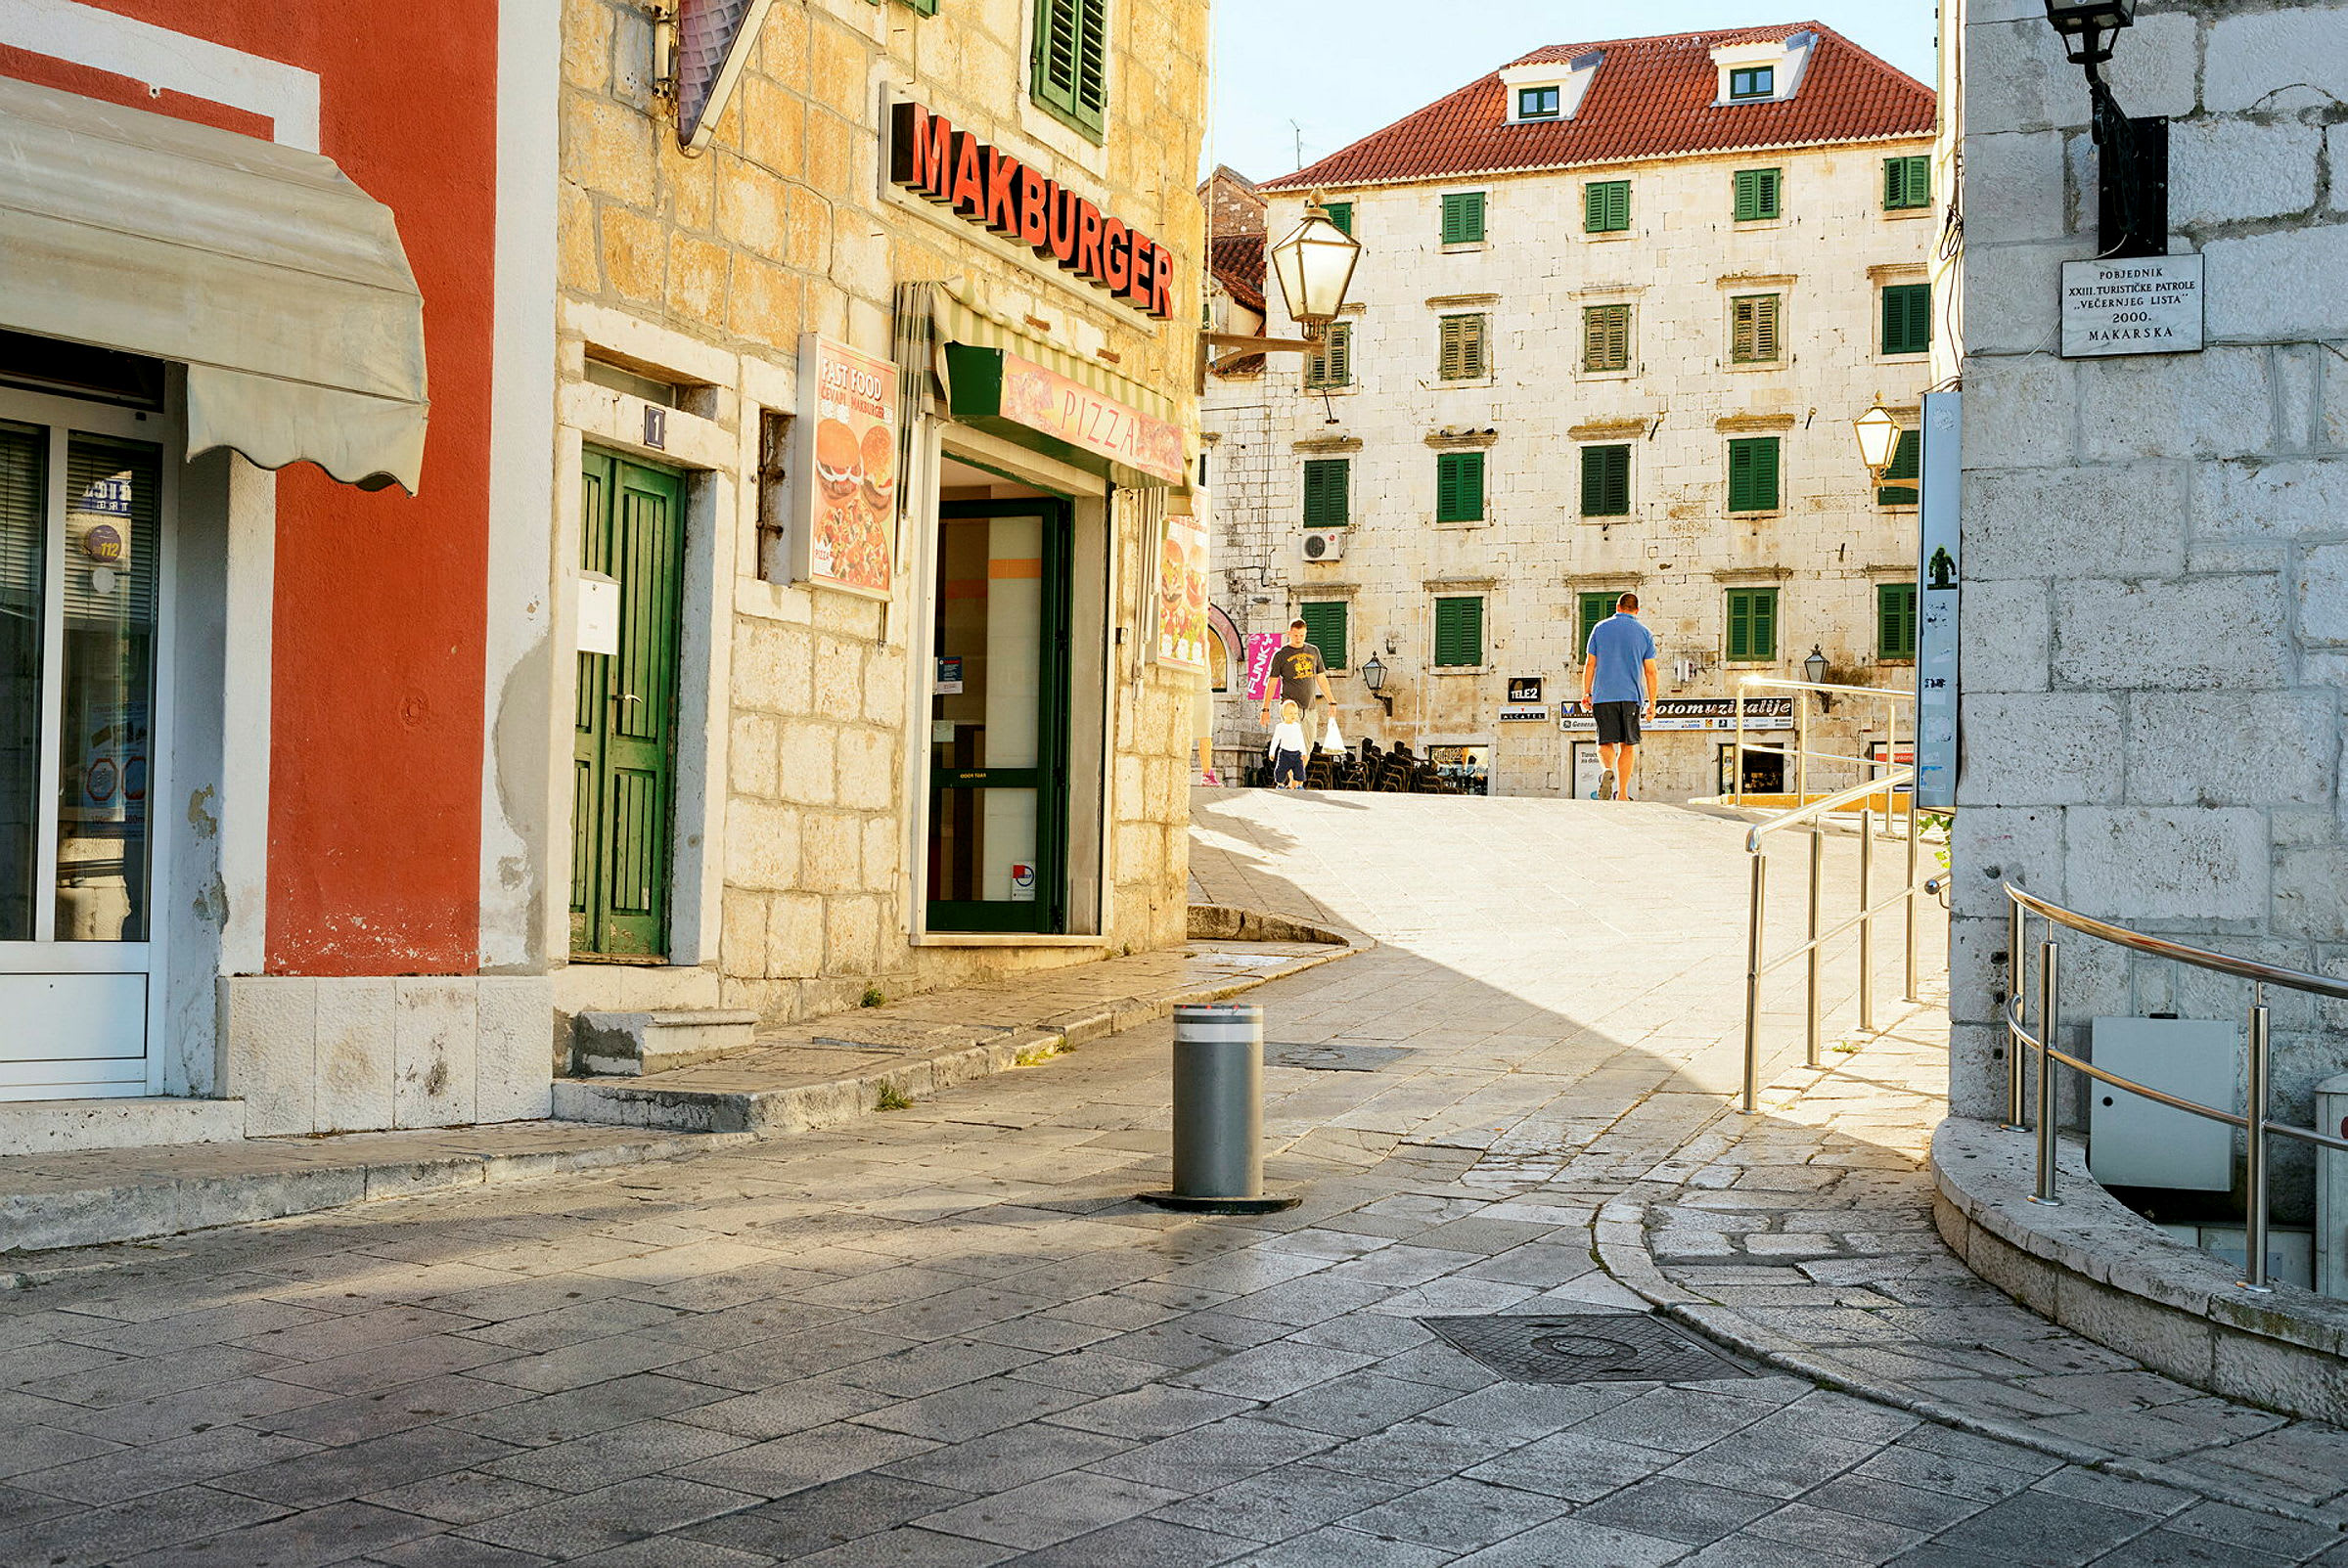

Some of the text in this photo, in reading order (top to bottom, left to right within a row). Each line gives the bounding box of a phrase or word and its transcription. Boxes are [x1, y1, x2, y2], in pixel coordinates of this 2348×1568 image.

[912, 102, 1173, 321] MAKBURGER
[2100, 267, 2163, 280] POBJEDNIK
[2097, 282, 2152, 295] TURISTIČKE
[2155, 281, 2195, 291] PATROLE
[2112, 311, 2152, 324] 2000.
[2089, 327, 2173, 341] MAKARSKA
[822, 356, 882, 401] FAST FOOD
[655, 415, 660, 441] 1
[1061, 390, 1134, 457] PIZZA
[102, 543, 118, 557] 112
[1511, 688, 1538, 699] TELE2
